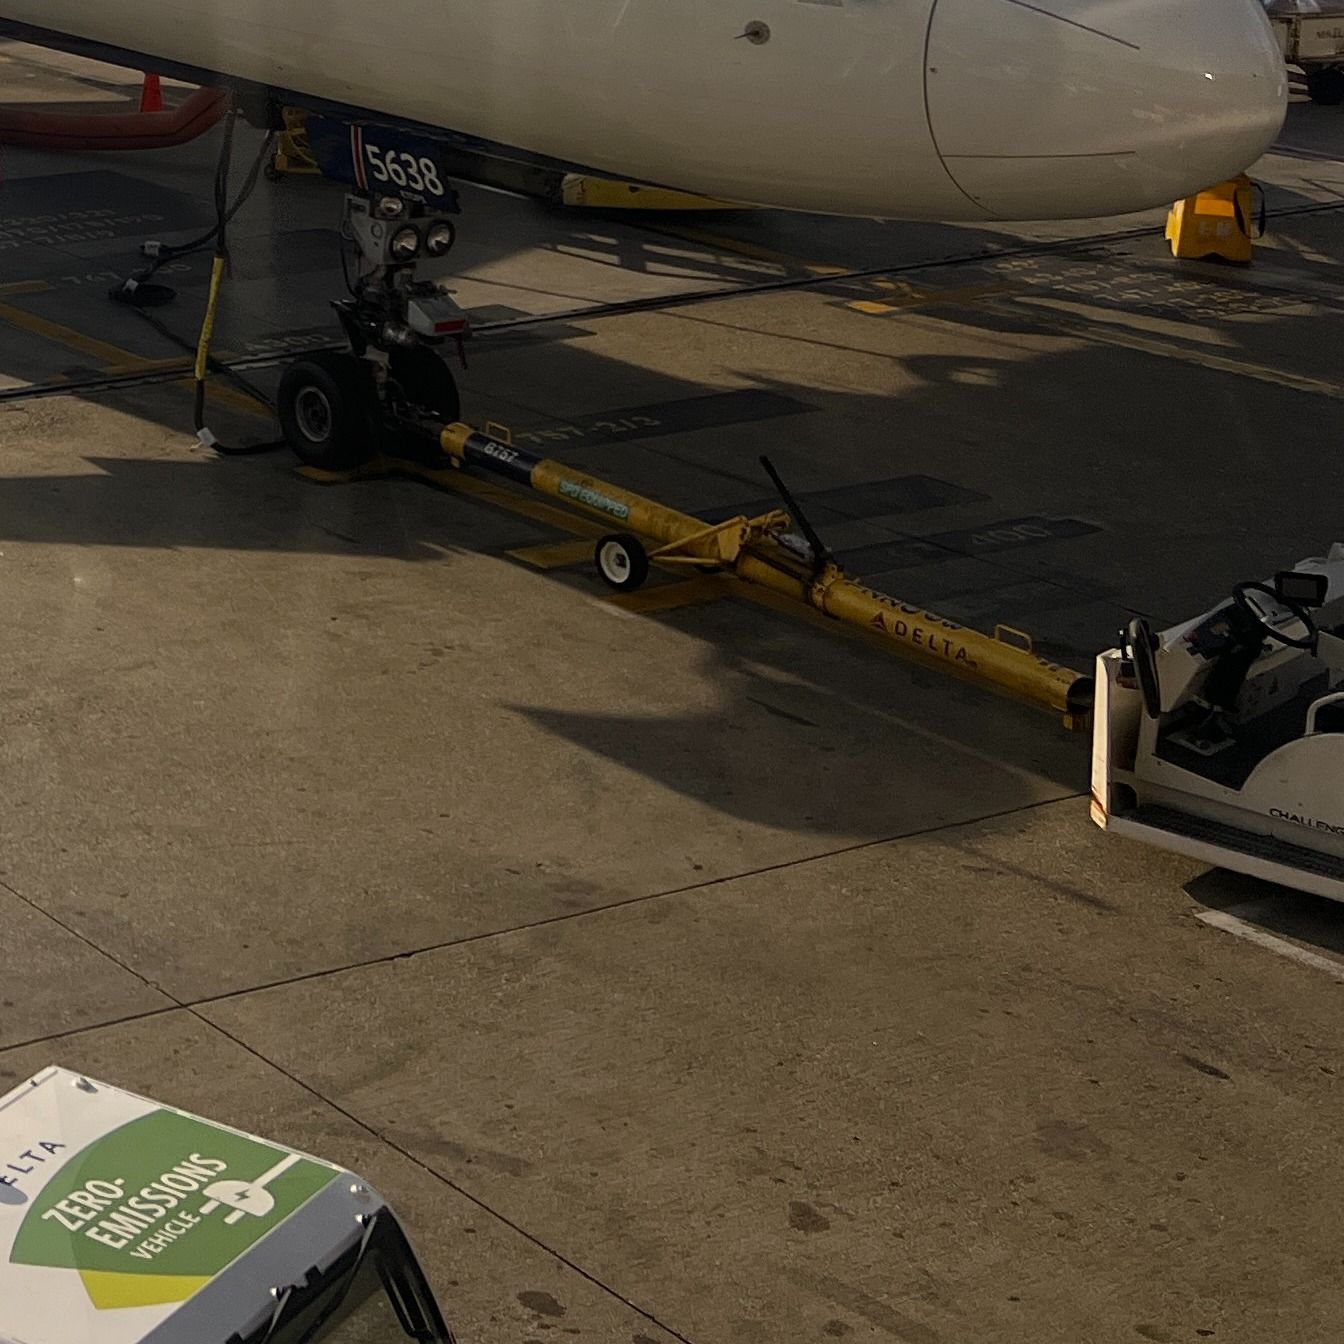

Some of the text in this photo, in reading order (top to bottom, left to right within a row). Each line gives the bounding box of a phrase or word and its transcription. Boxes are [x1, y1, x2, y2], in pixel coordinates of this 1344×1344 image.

[365, 143, 435, 196] 5638
[894, 620, 969, 662] DELTA
[41, 1175, 128, 1232] ZERO-
[83, 1152, 229, 1250] EMISSIONS
[129, 1209, 203, 1261] VEHICLE
